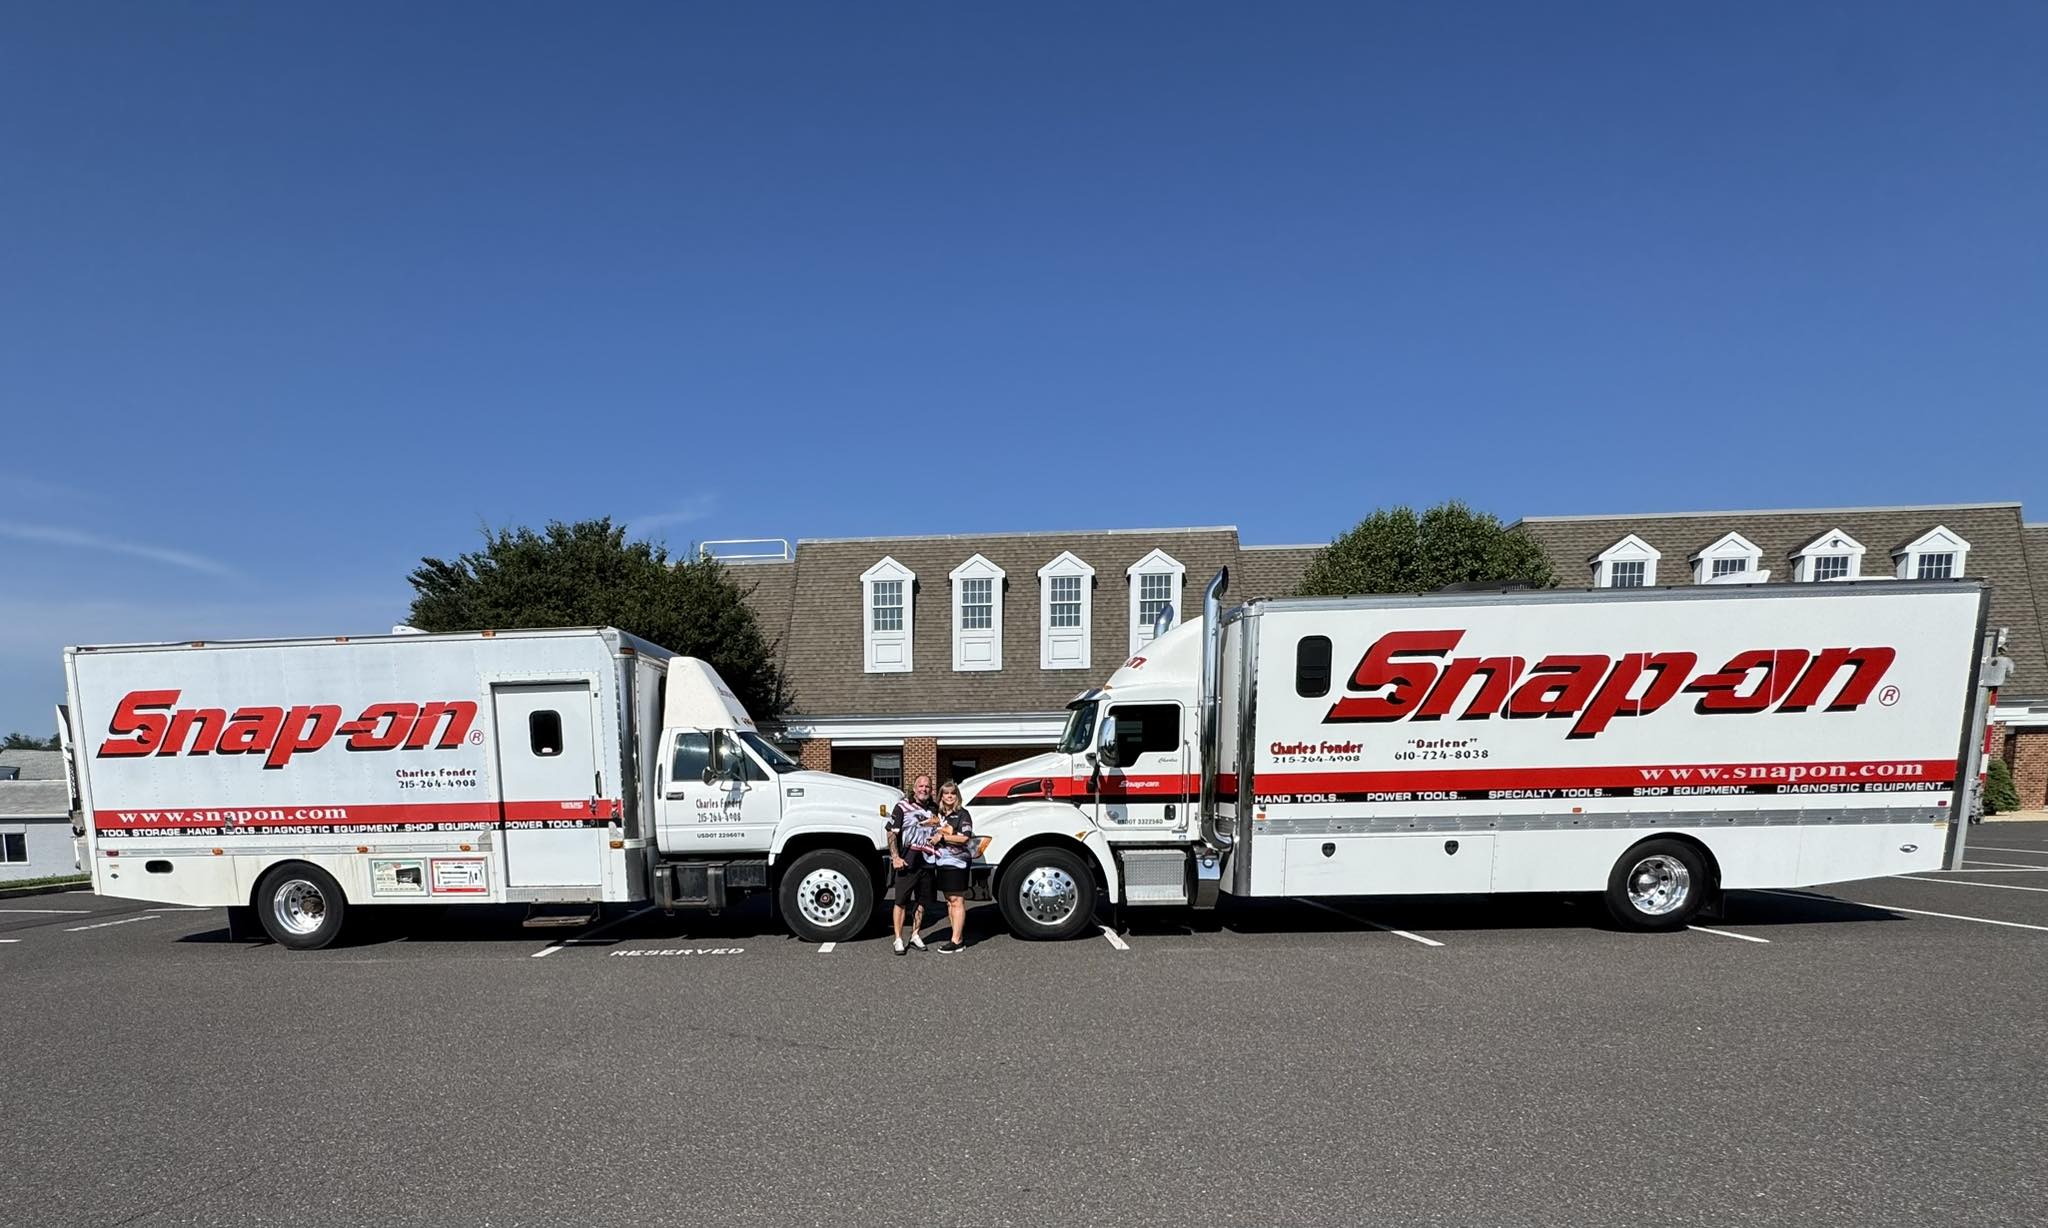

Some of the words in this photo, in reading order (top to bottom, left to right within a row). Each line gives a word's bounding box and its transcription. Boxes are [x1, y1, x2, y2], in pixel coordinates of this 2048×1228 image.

[1321, 629, 1896, 740] Snap-on
[96, 689, 478, 770] Snap-on
[1269, 741, 1316, 755] Charles
[1320, 740, 1363, 754] Fonder
[1272, 755, 1360, 763] 215-264-4908
[1394, 749, 1489, 761] 610-724-8038
[395, 768, 436, 778] Charles
[440, 767, 477, 777] Fonder
[1640, 762, 1923, 781] www.snapon.com
[398, 779, 477, 789] 215-264-4908
[1776, 783, 1859, 793] DIAGNOSTIC
[1367, 792, 1412, 801] POWER
[1488, 789, 1556, 799] SPECIALTY
[1633, 787, 1668, 796] SHOP
[696, 798, 719, 809] Charles
[1254, 794, 1291, 804] HAND
[117, 808, 347, 825] www.snapon.com
[262, 825, 330, 835] DIAGNOSTIC
[404, 823, 434, 832] SHOP
[504, 821, 543, 829] POWER
